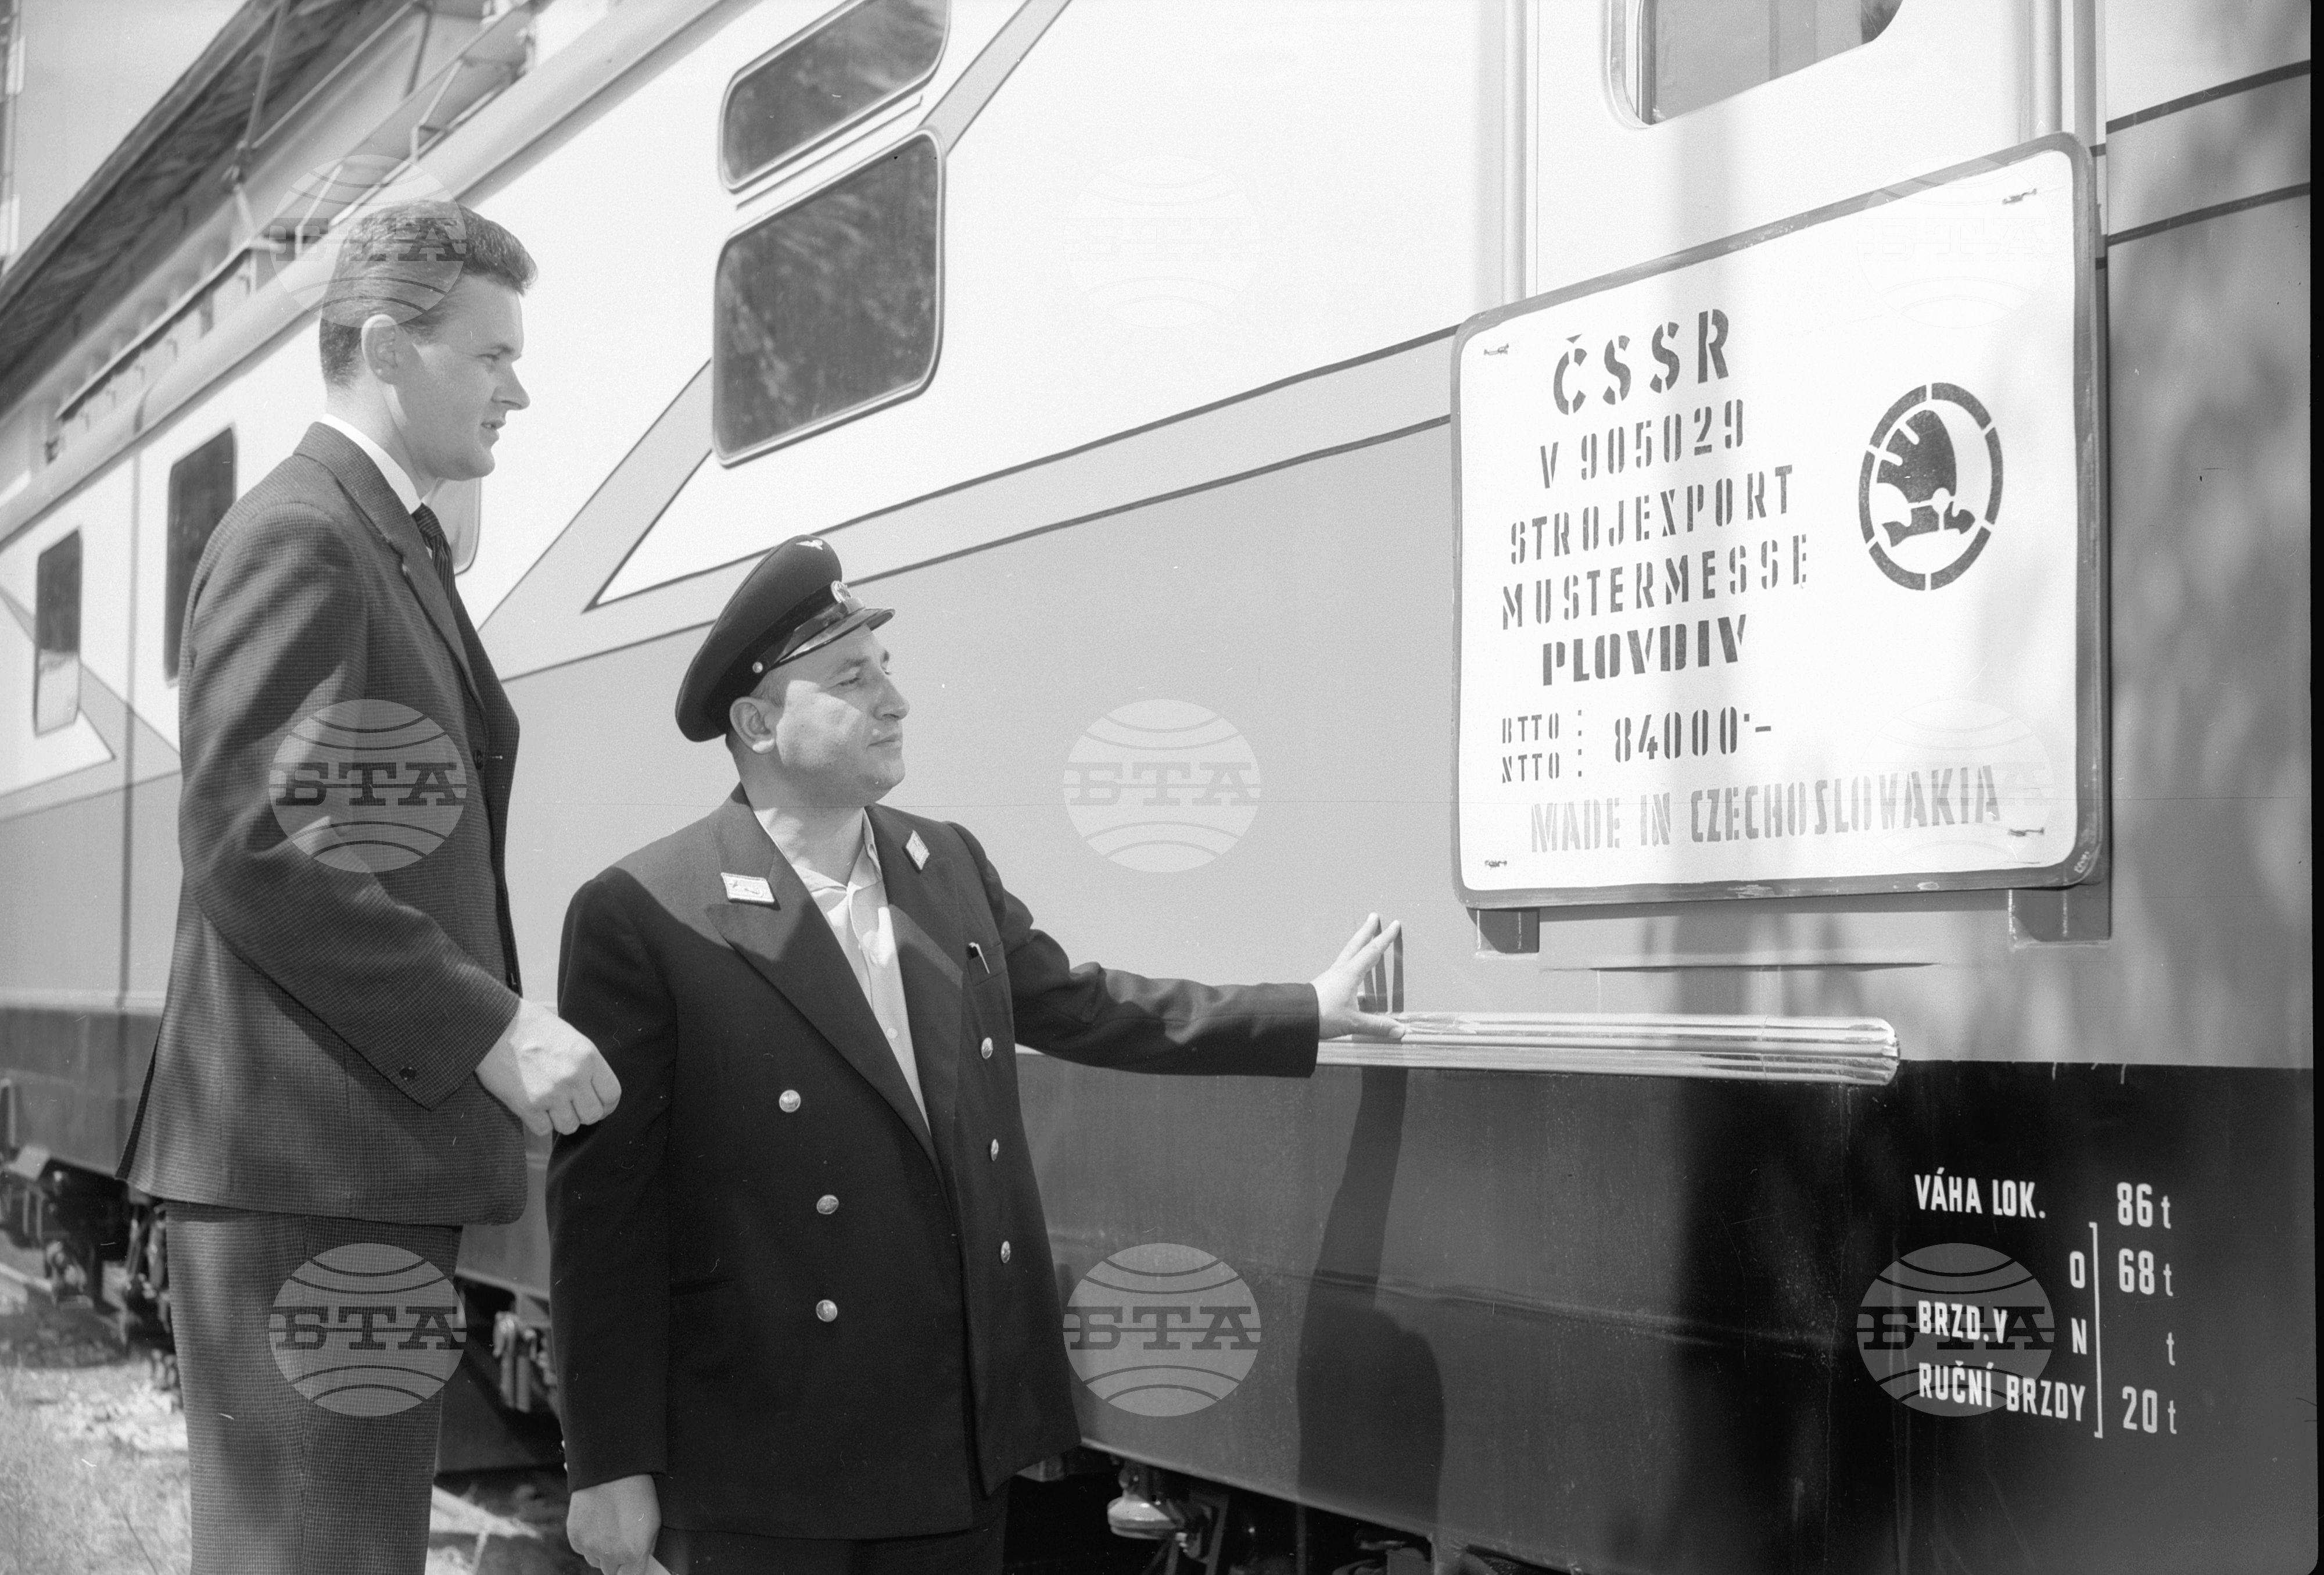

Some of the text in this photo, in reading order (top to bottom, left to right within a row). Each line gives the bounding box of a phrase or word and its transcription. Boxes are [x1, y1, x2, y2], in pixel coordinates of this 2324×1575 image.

[1553, 308, 1730, 416] ČSSR
[1540, 399, 1743, 489] V 905029
[1511, 464, 1793, 564] STROJEXPORT
[1502, 534, 1807, 630] MUSTERMESSE
[1543, 614, 1746, 686] PLOVDIV
[1502, 752, 1559, 783] NTTO
[1532, 797, 1620, 853] MADE
[1640, 792, 1670, 846] IN
[1914, 1167, 2171, 1229] VÁHA LOK. 86 t
[2118, 1248, 2156, 1295] 68
[2163, 1263, 2174, 1297] t
[2071, 1318, 2088, 1355] N
[2166, 1332, 2175, 1366] t
[1918, 1360, 2177, 1434] RUČNÍ BRZDY 20 t
